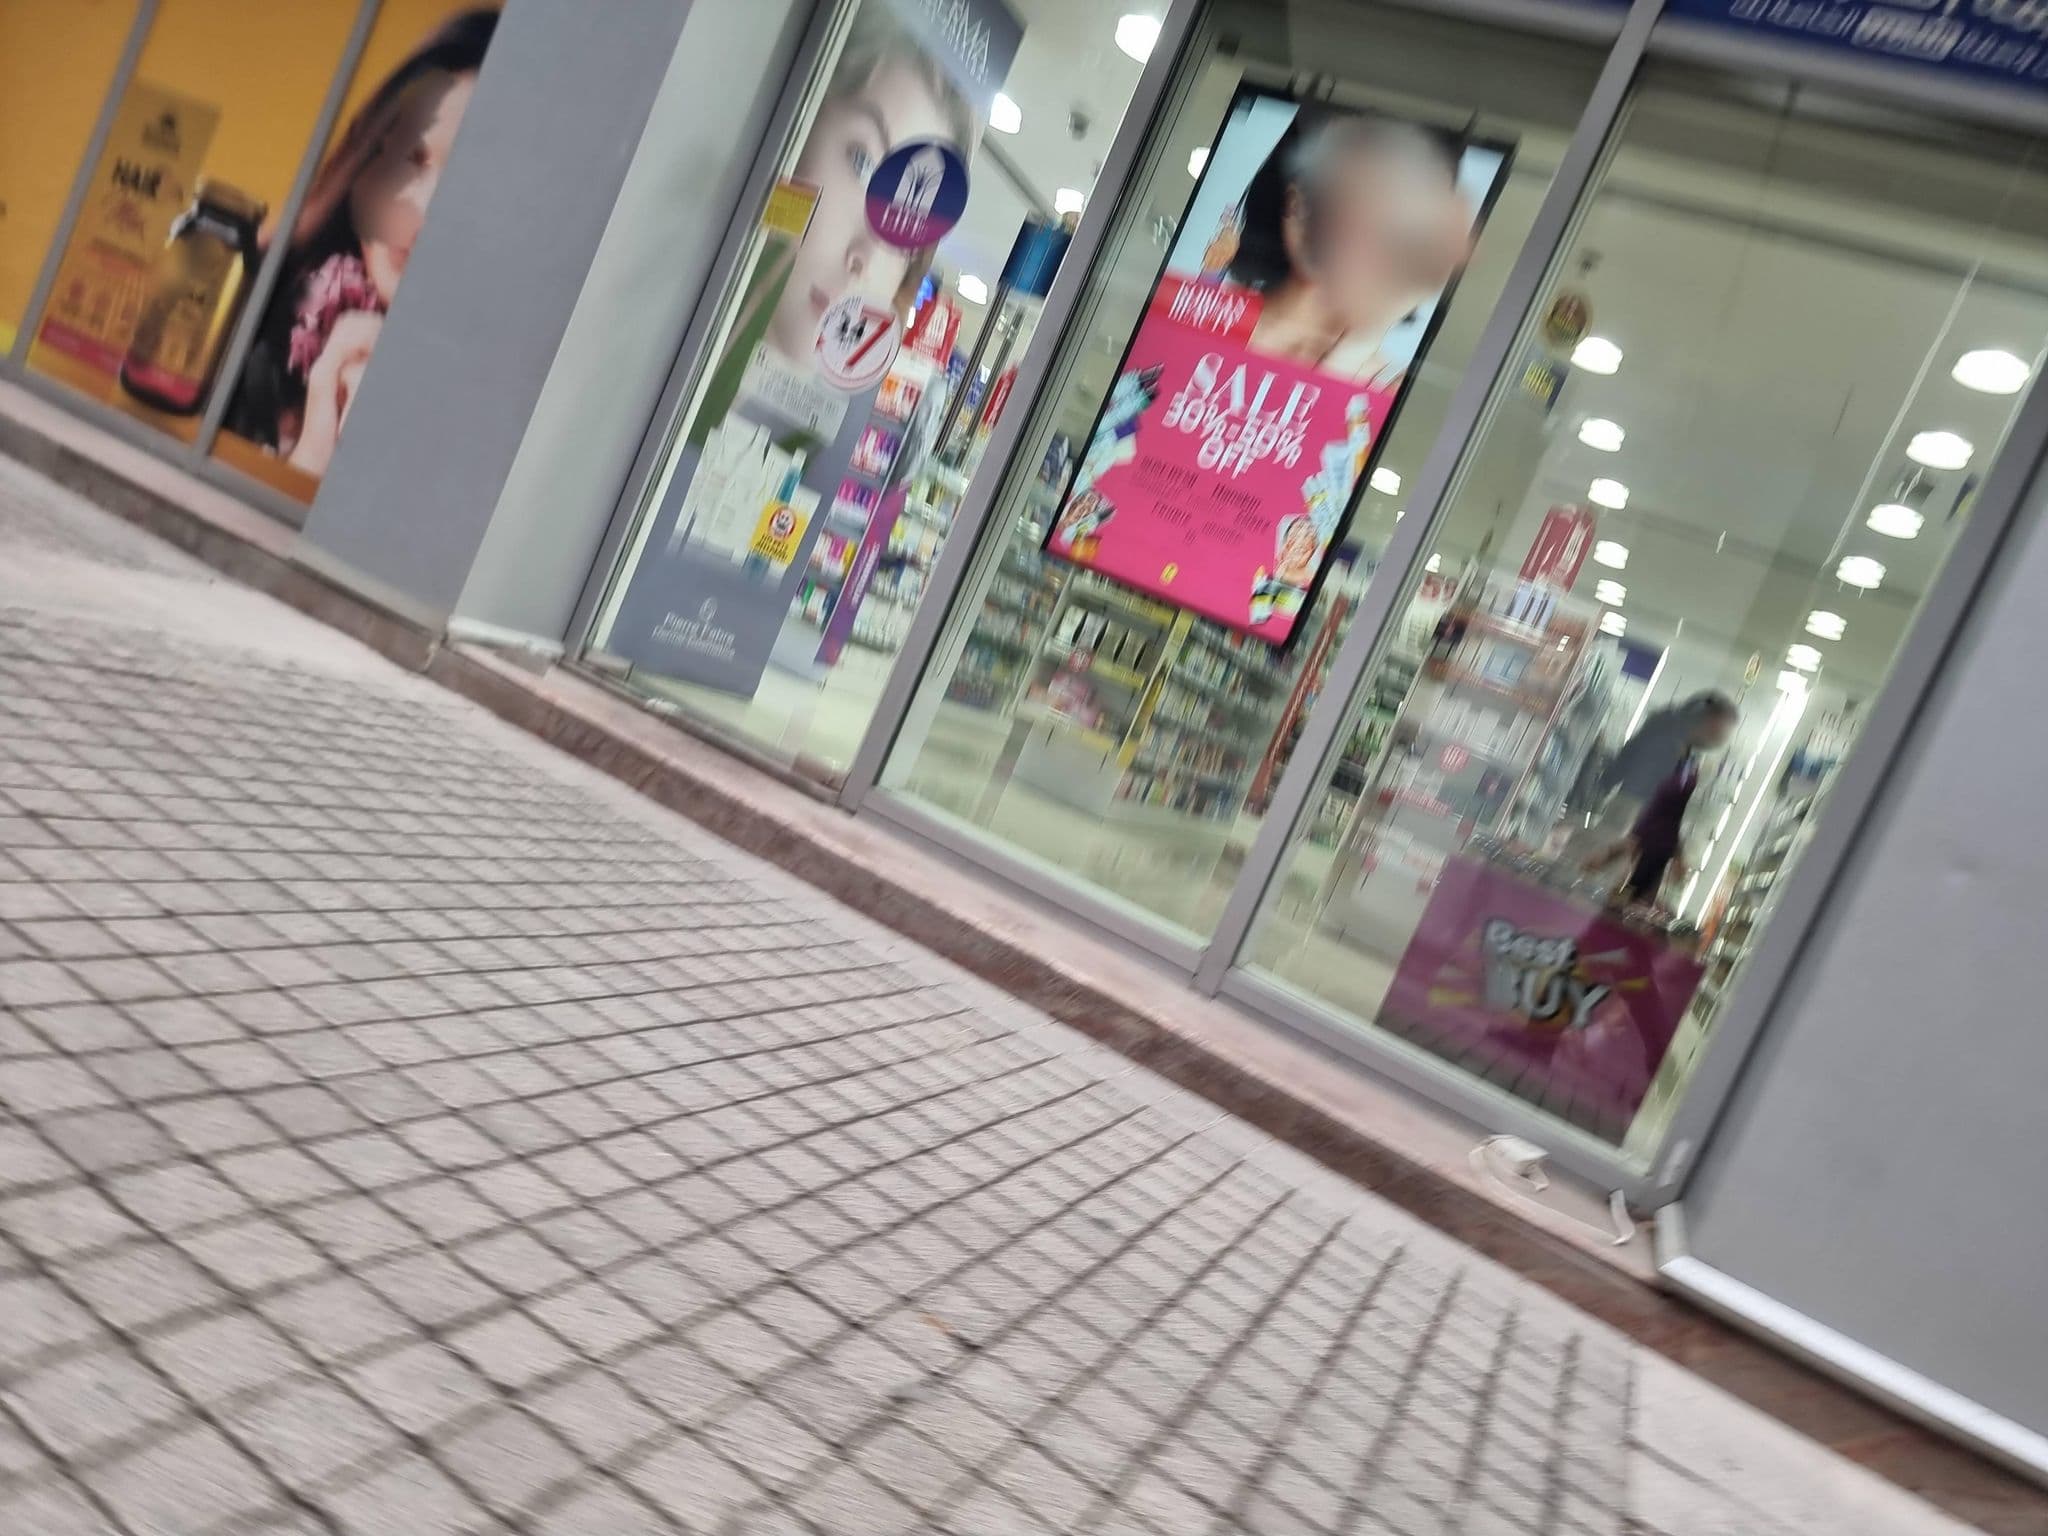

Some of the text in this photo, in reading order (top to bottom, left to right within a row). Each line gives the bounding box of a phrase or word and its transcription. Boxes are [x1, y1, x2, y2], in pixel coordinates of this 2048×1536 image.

[1181, 353, 1322, 433] SALE
[1197, 436, 1260, 480] OFF
[1484, 917, 1577, 970] Best
